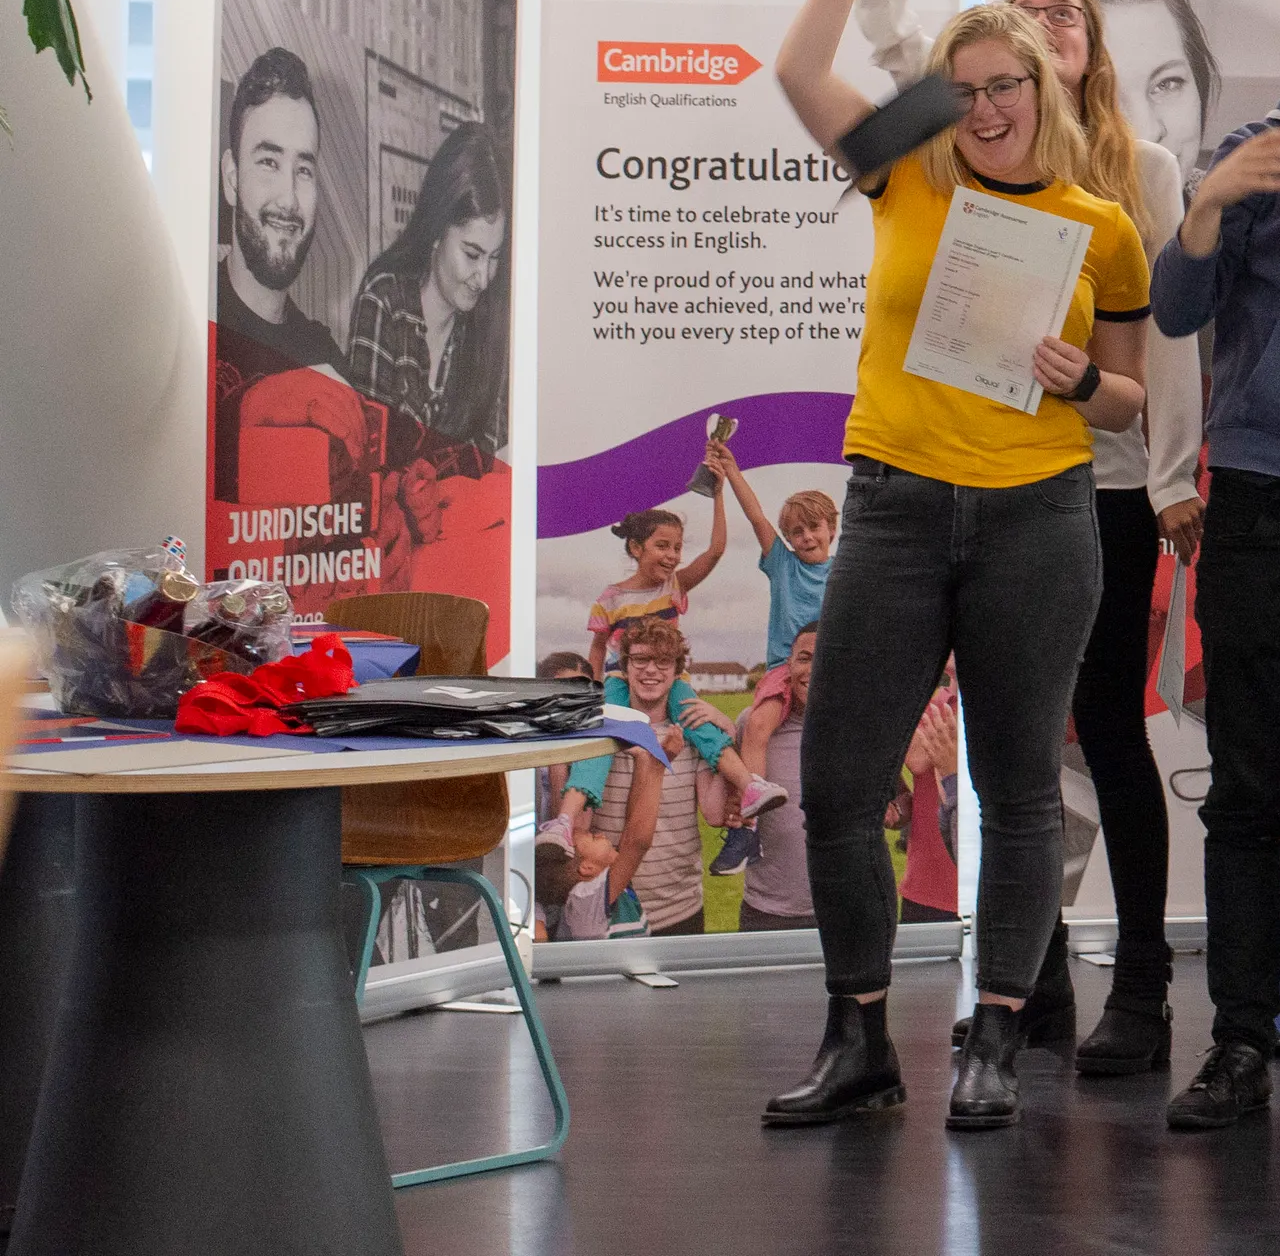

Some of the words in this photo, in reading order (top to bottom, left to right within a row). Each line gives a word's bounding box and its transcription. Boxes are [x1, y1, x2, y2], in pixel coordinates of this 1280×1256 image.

[603, 47, 739, 81] Cambridge
[603, 92, 647, 108] English
[650, 92, 737, 108] Qualifications
[596, 147, 854, 191] Congratulatio
[594, 204, 623, 222] It's
[628, 205, 671, 223] time
[676, 209, 697, 223] to
[702, 205, 790, 224] celebrate
[795, 210, 839, 228] your
[594, 234, 665, 249] success
[670, 231, 688, 249] in
[694, 231, 767, 254] English.
[593, 270, 648, 289] We're
[654, 270, 710, 292] proud
[715, 270, 736, 289] of
[739, 275, 775, 293] you
[780, 271, 814, 289] and
[819, 271, 867, 289] what
[592, 300, 628, 319] you
[634, 296, 679, 314] have
[684, 296, 774, 317] achieved,
[779, 296, 813, 314] and
[818, 297, 866, 315] we're
[593, 322, 635, 340] with
[640, 326, 676, 344] you
[681, 326, 734, 344] every
[740, 324, 780, 344] step
[785, 322, 804, 340] of
[808, 322, 840, 340] the
[228, 502, 363, 544] JURIDISCHE
